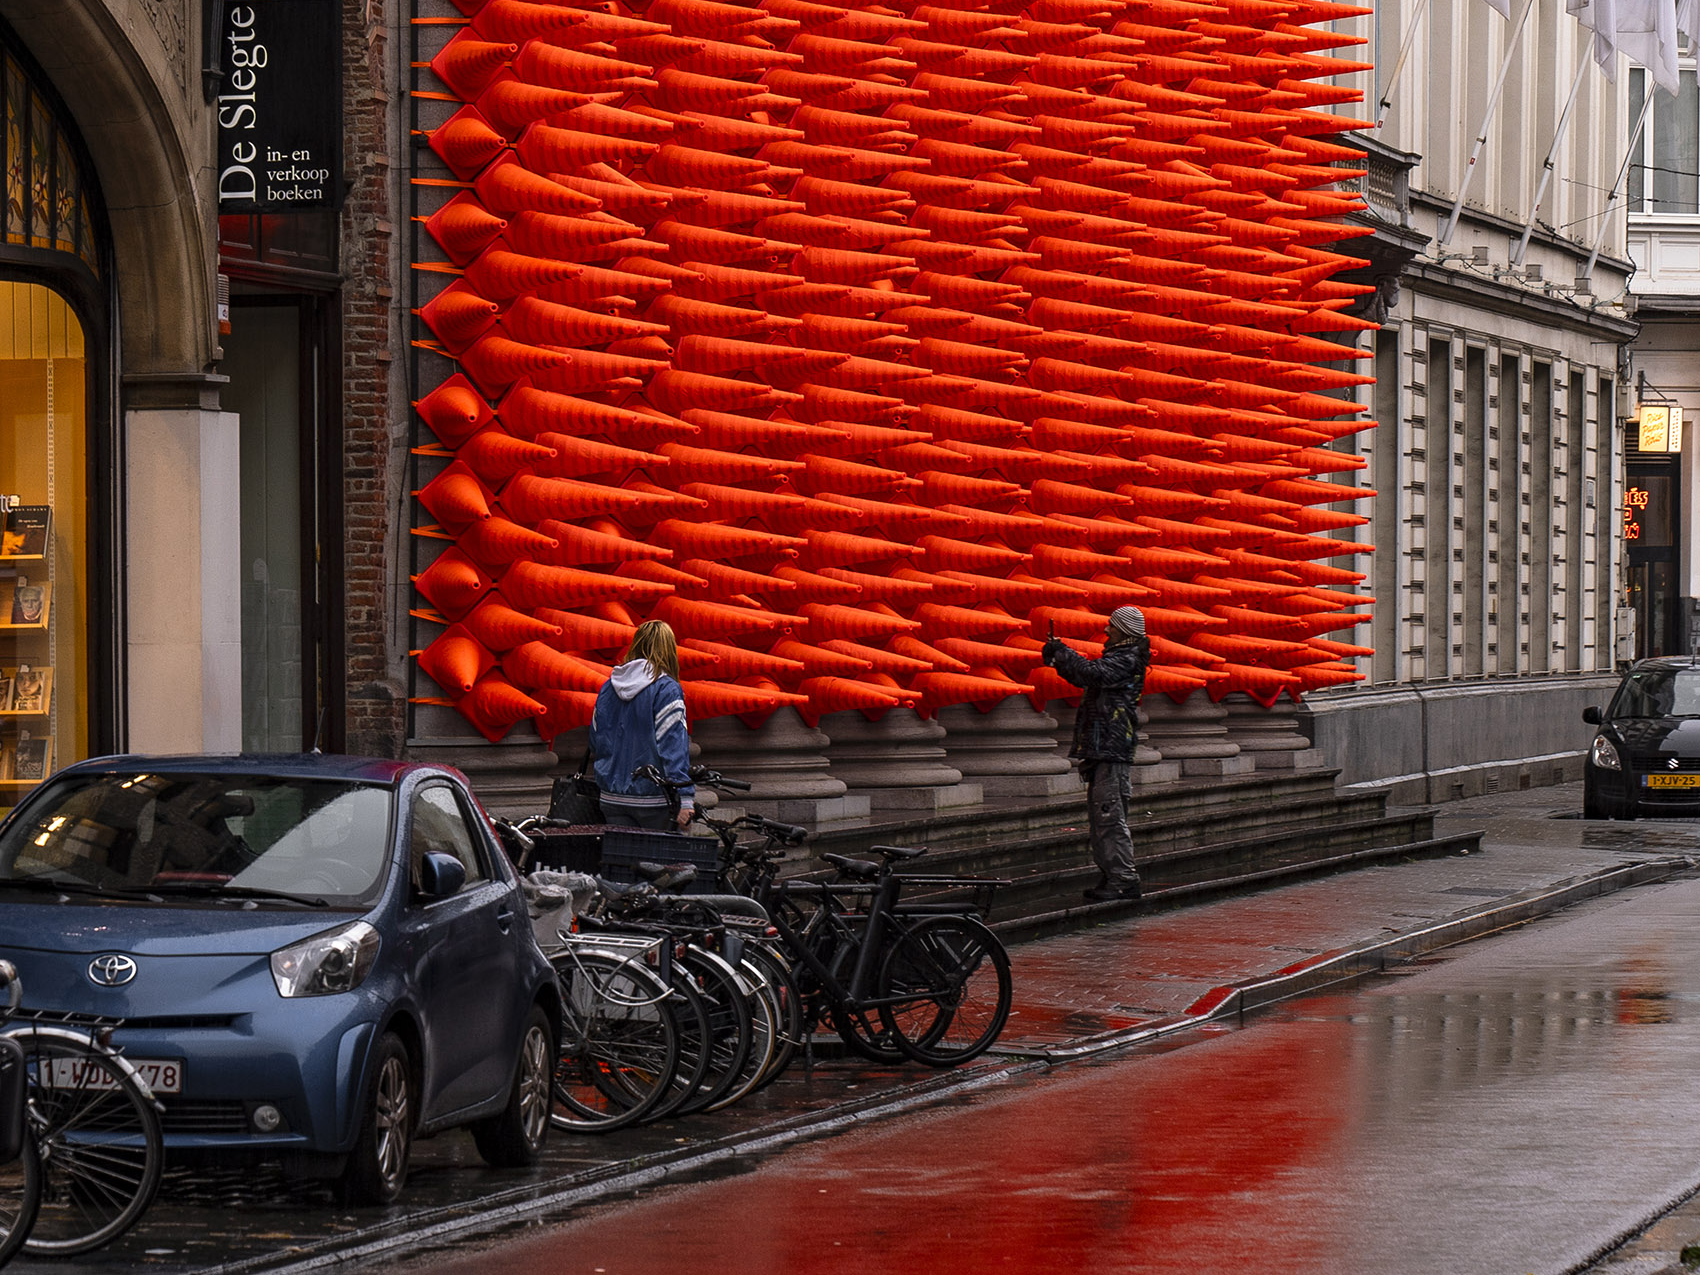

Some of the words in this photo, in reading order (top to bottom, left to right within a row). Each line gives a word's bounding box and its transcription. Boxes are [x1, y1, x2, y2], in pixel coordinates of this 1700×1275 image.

[218, 6, 268, 129] Slegte
[267, 146, 288, 162] in-
[292, 149, 310, 161] en
[218, 141, 257, 203] De
[267, 165, 329, 184] verkoop
[267, 186, 323, 201] boeken
[1652, 776, 1696, 786] 1-XJV-25
